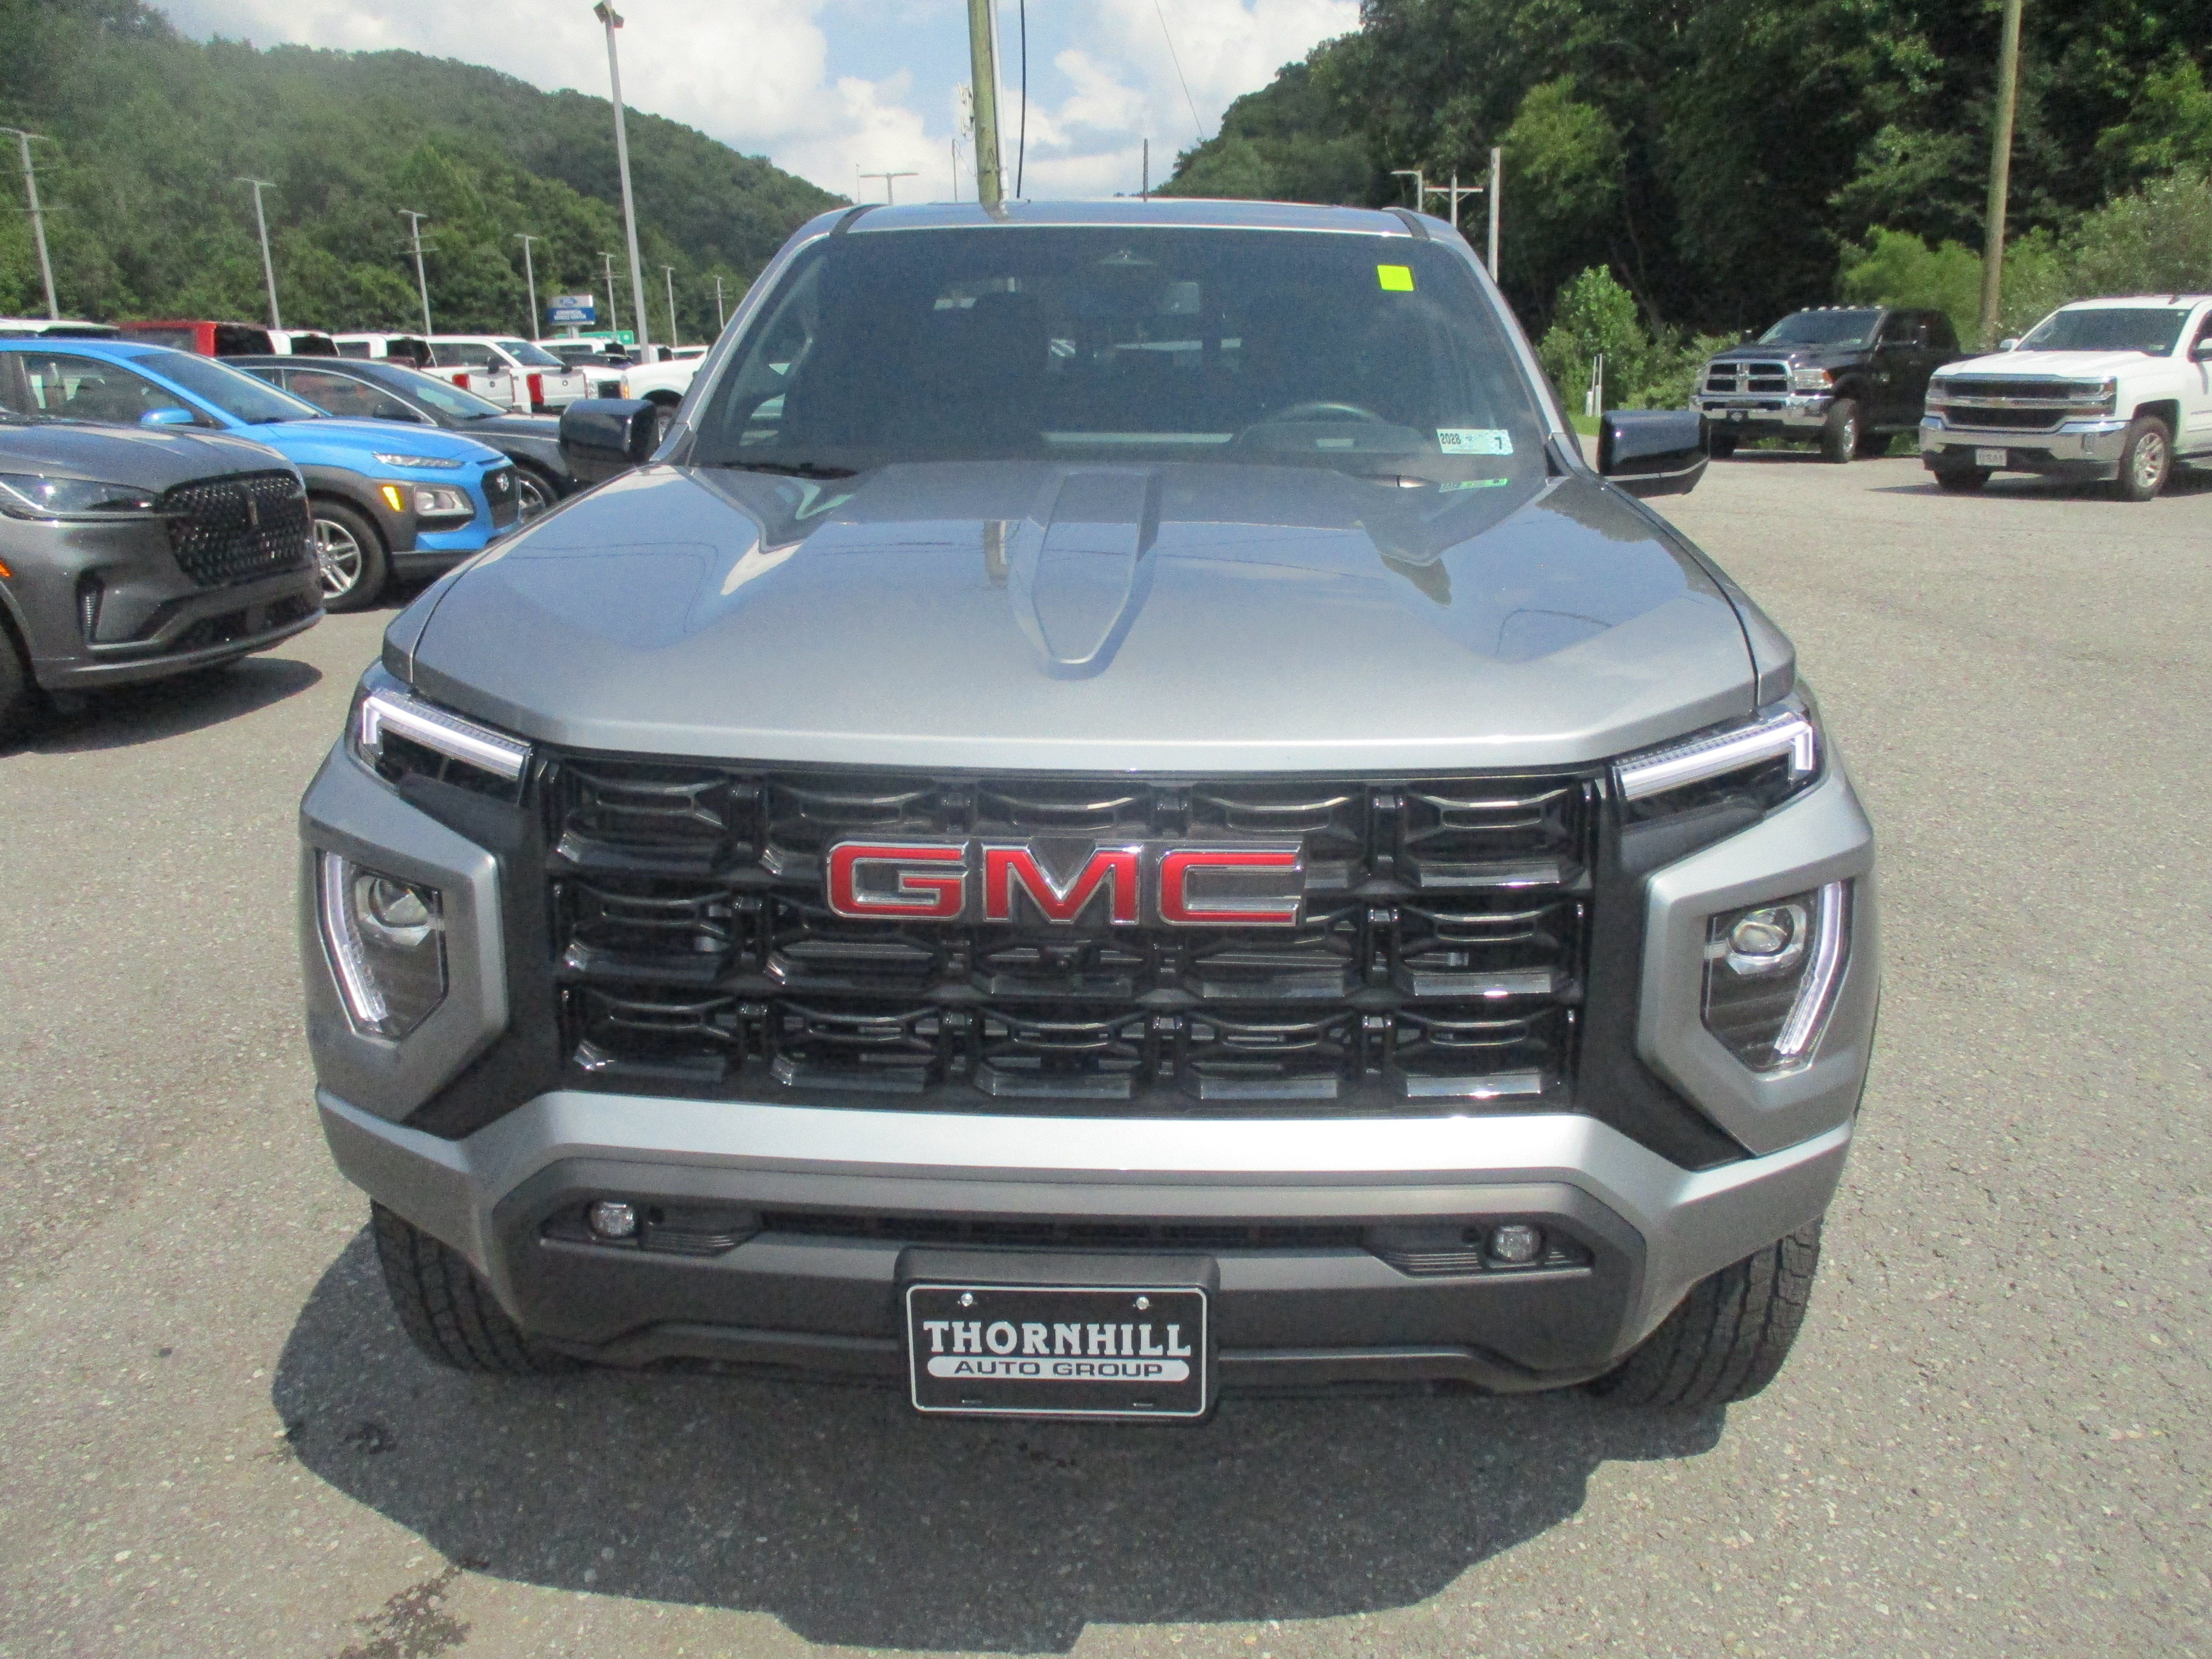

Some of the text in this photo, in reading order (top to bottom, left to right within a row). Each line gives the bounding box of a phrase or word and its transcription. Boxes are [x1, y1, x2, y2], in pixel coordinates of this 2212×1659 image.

[1440, 433, 1502, 450] 2028 7
[826, 840, 1302, 927] GMC
[923, 1321, 1191, 1357] THORNHILL
[954, 1361, 1163, 1377] AUTO GROUP
